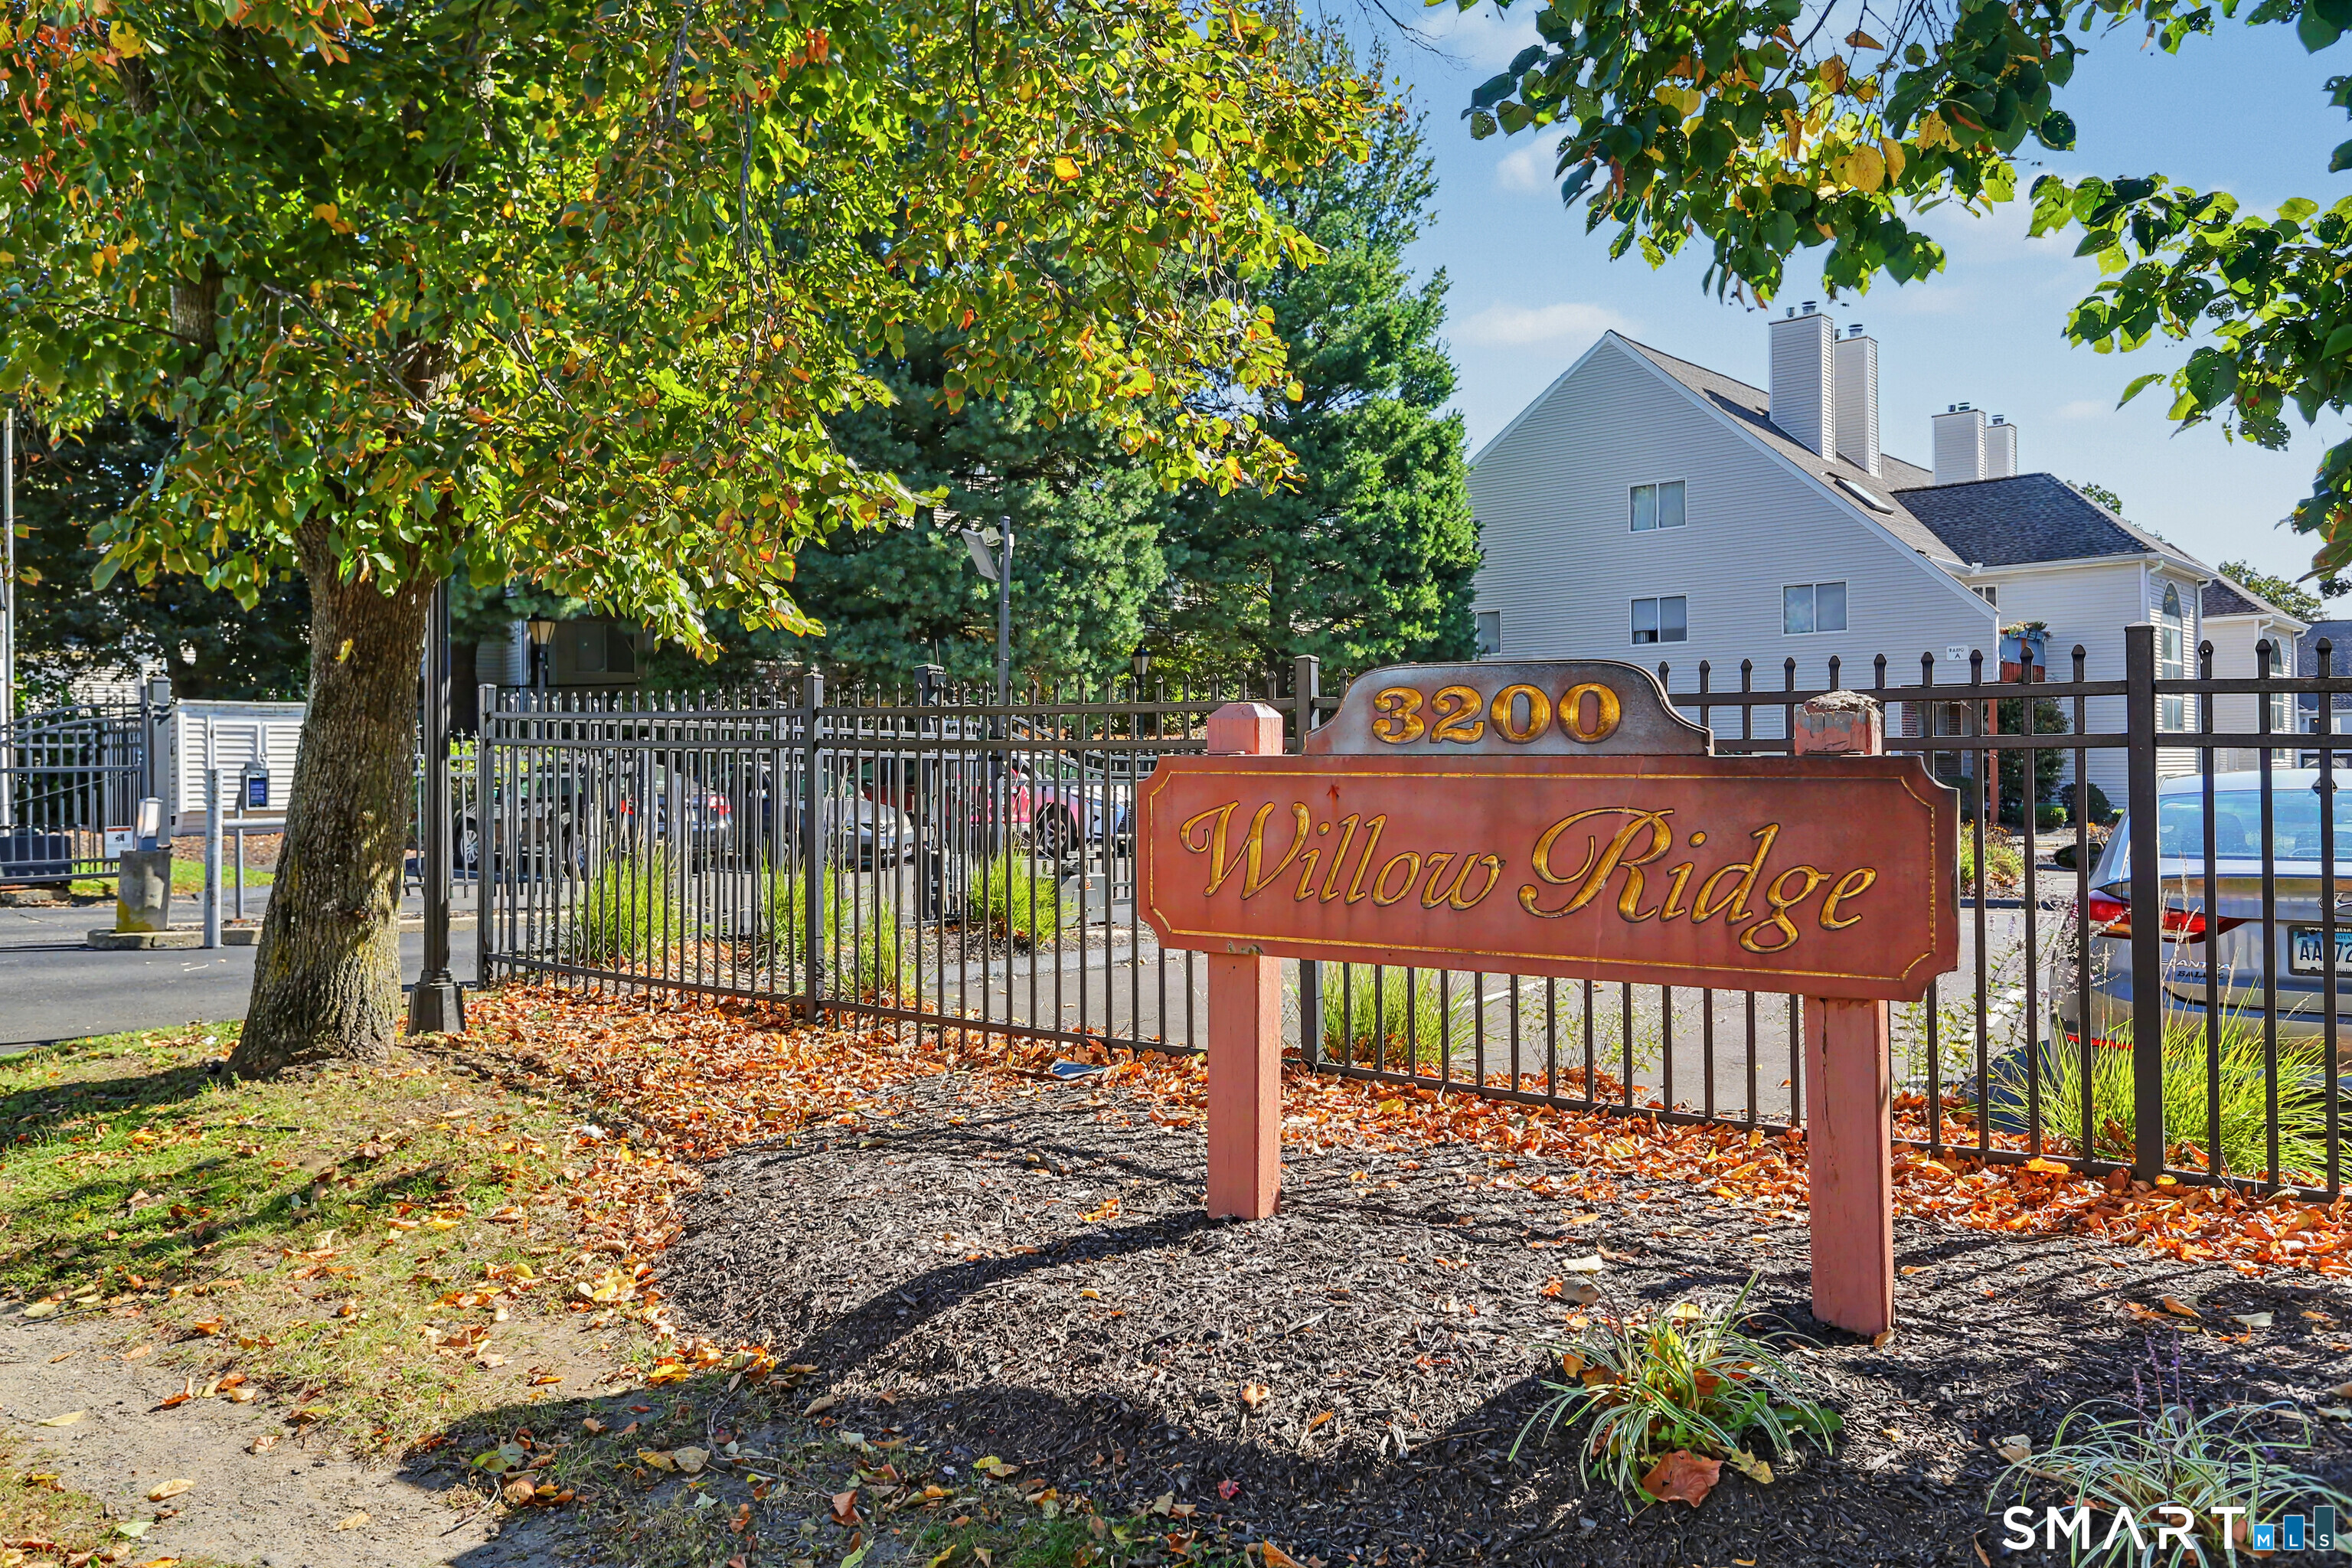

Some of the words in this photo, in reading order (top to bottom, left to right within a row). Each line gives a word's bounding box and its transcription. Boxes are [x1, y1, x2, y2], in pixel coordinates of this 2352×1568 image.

[1371, 682, 1622, 745] 3200
[1179, 800, 1506, 911] Willow
[1518, 806, 1878, 955] Ridge
